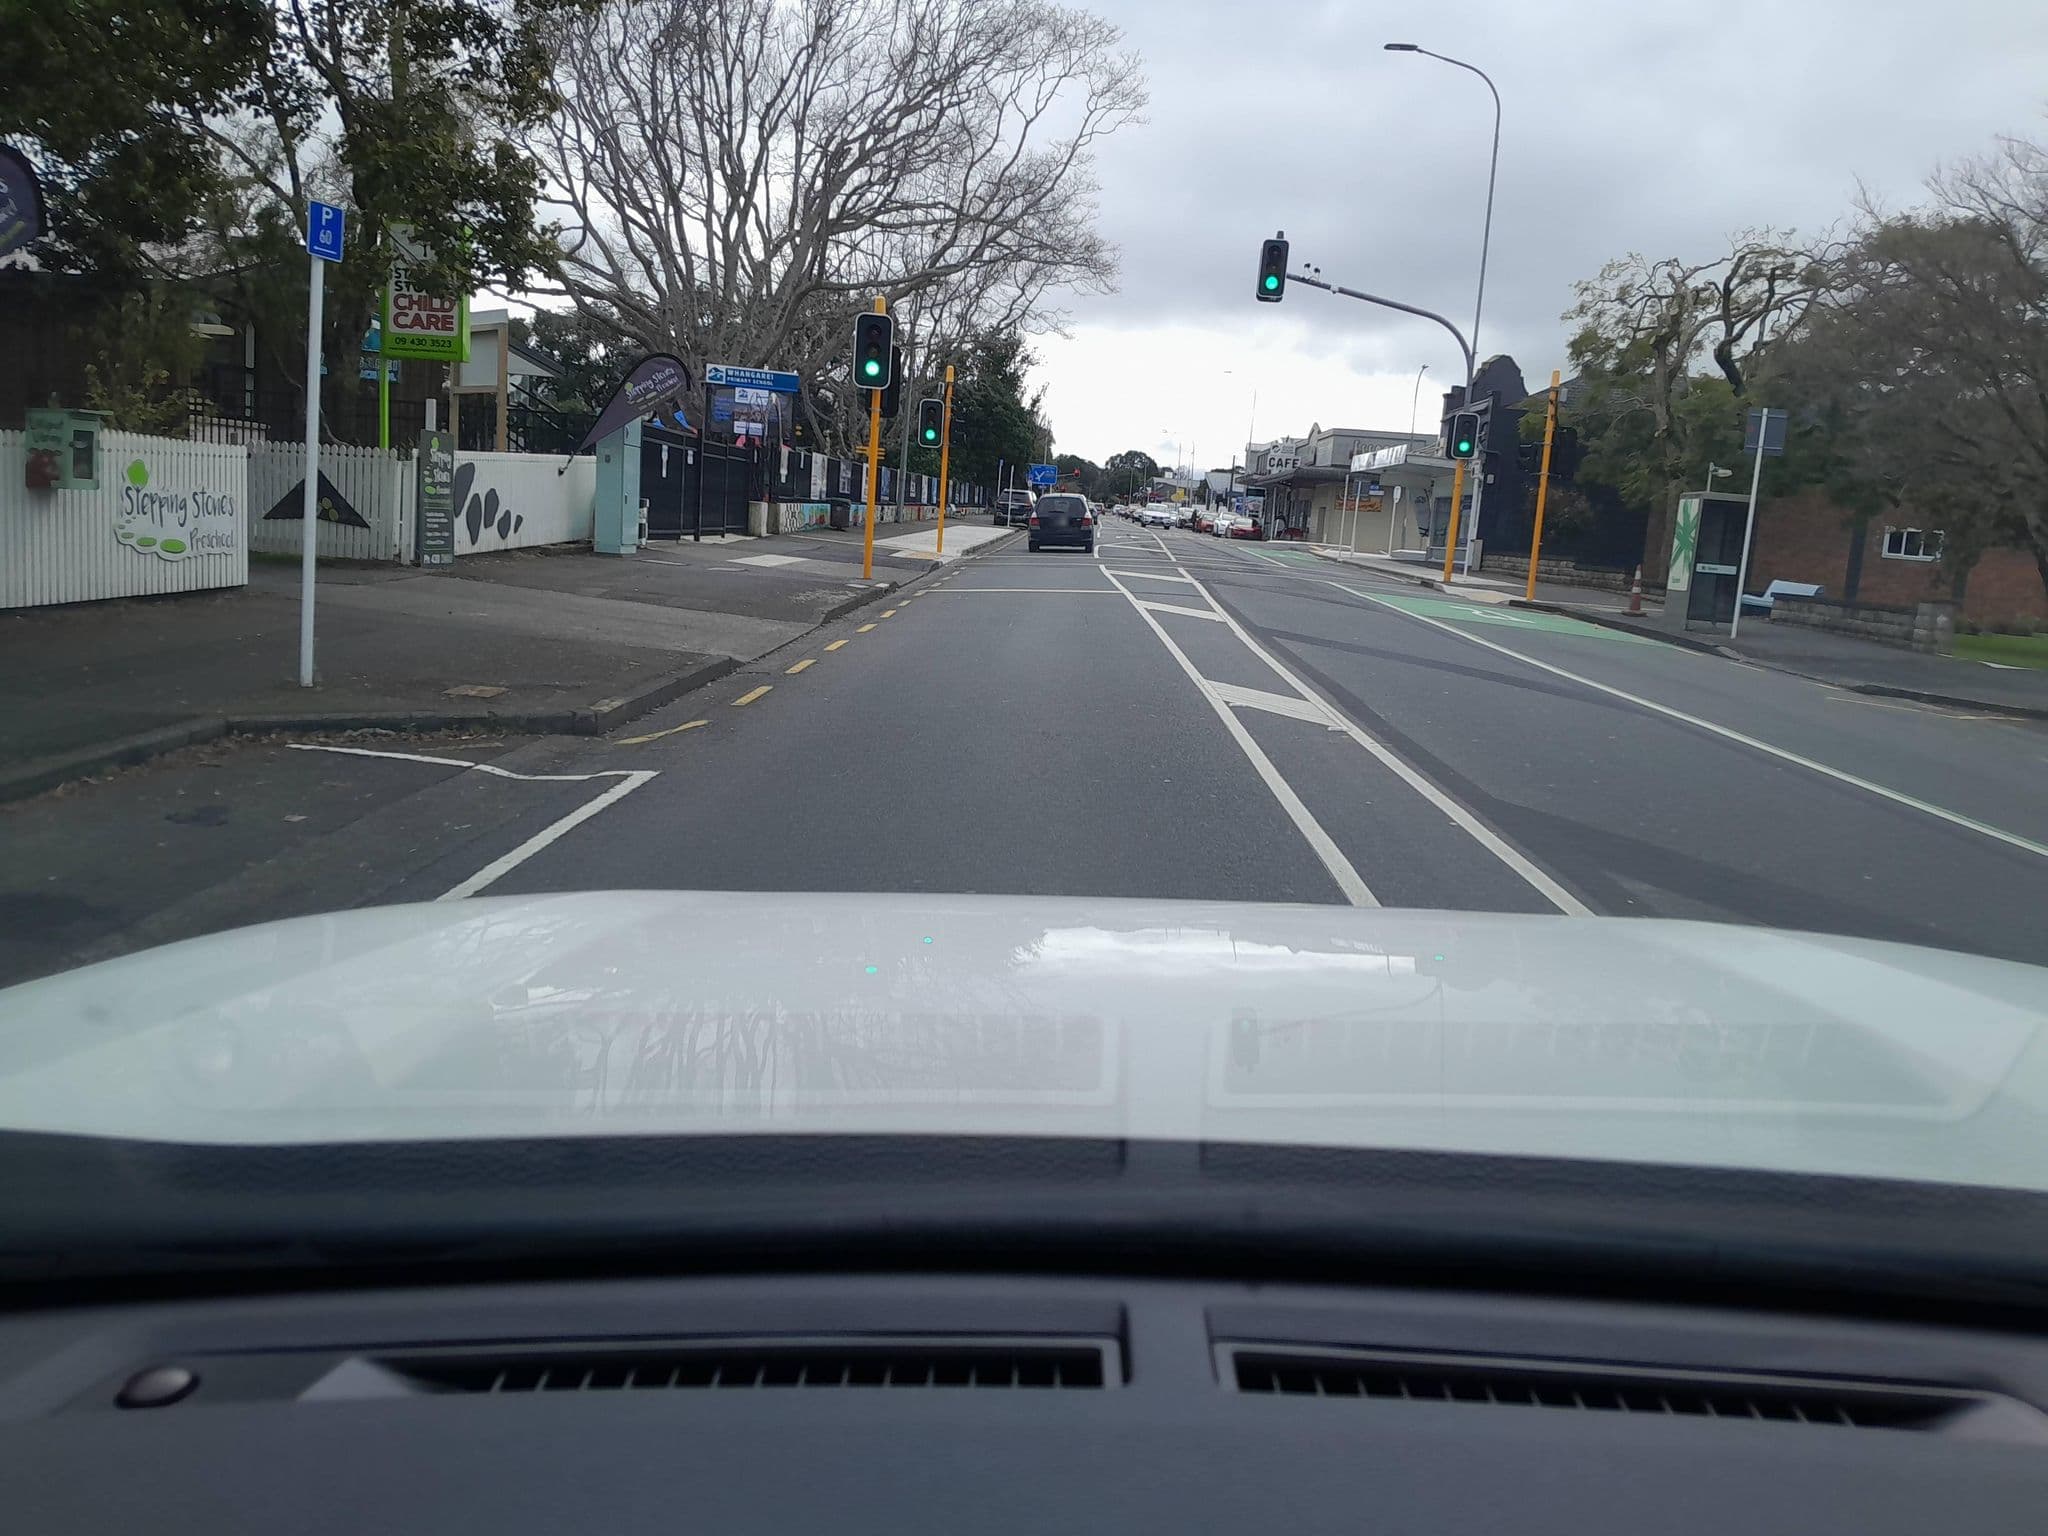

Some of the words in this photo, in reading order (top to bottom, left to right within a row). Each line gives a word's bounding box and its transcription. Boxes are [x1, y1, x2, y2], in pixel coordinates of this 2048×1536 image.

[321, 205, 334, 226] P
[319, 229, 333, 246] 60
[393, 293, 456, 313] CHILD
[393, 312, 455, 332] CARE
[395, 336, 407, 346] 09
[410, 338, 428, 347] 430
[430, 339, 453, 349] 3523
[727, 368, 775, 381] WHANGAREI
[752, 378, 774, 387] SCHOOL
[1268, 456, 1301, 470] CAFE
[125, 485, 188, 529] Stepping
[191, 486, 235, 519] Stones
[189, 527, 235, 552] Preschool
